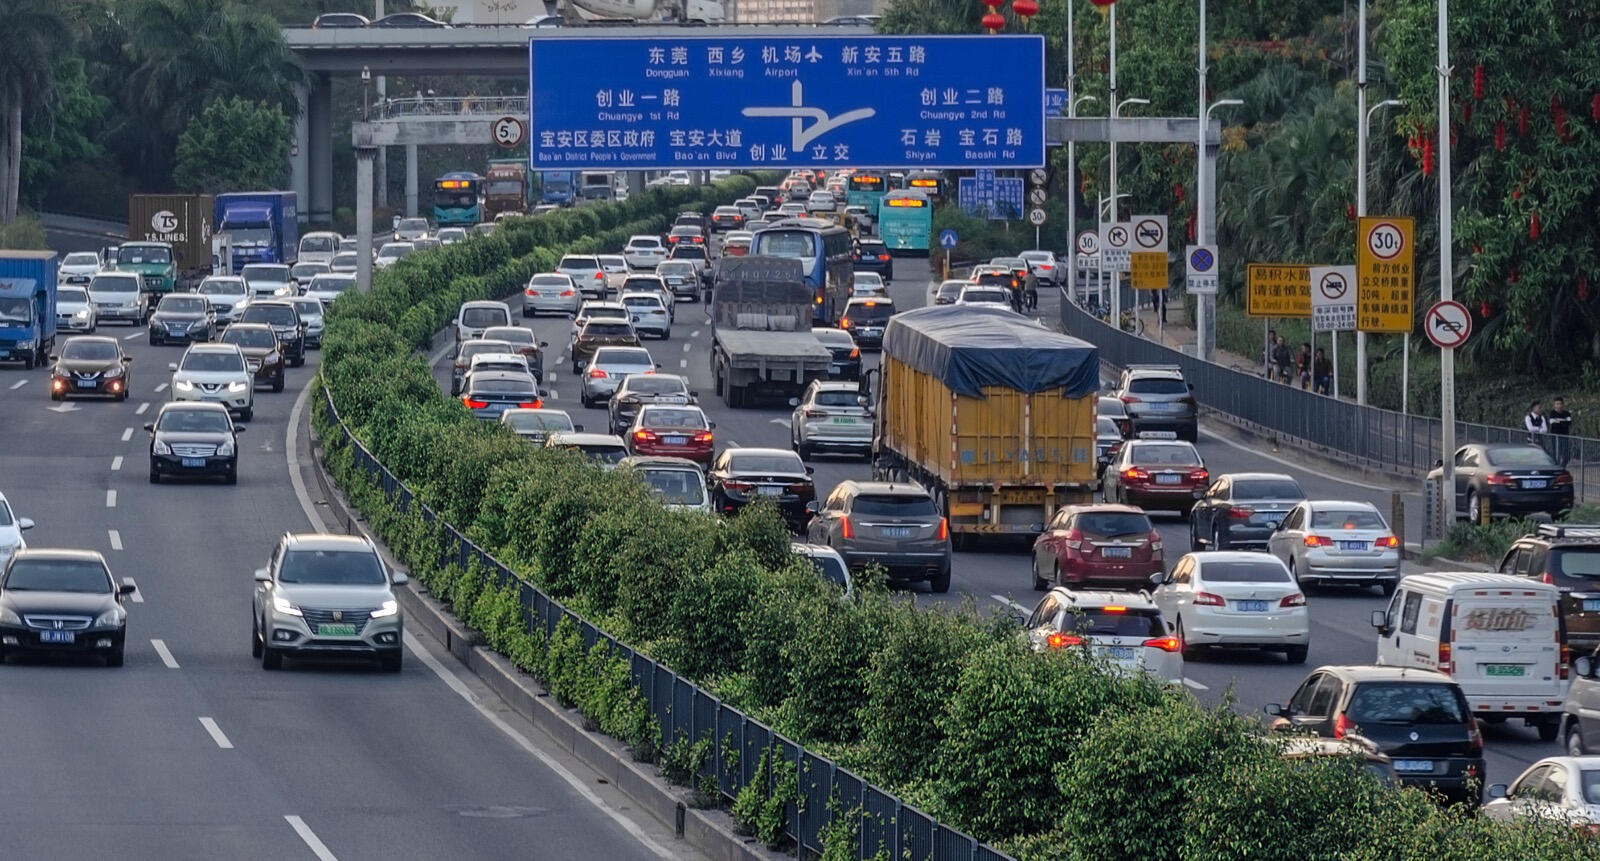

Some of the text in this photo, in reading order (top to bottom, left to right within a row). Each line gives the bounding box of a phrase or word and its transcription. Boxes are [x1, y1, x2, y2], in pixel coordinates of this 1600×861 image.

[648, 45, 925, 65] 东莞 西乡 机场 新安五路
[646, 69, 689, 79] Dongguan
[710, 69, 744, 79] Xixiang
[765, 69, 798, 78] Airport
[884, 68, 899, 77] 5th
[906, 68, 919, 77] Rd
[596, 88, 680, 108] 创业一路
[920, 87, 1004, 106] 创业二路
[598, 112, 679, 122] Chuangye 1st Rd
[920, 111, 1005, 121] Chuangye 2nd Rd
[540, 129, 742, 149] 宝安区委区政府 宝安大道
[901, 128, 1023, 147] 石岩 宝石路
[565, 152, 588, 161] District
[620, 152, 656, 161] Government
[716, 151, 737, 161] Blvd
[750, 143, 850, 162] 创业 立交
[905, 150, 937, 161] Shiyan
[965, 150, 1016, 160] Baoshi Rd
